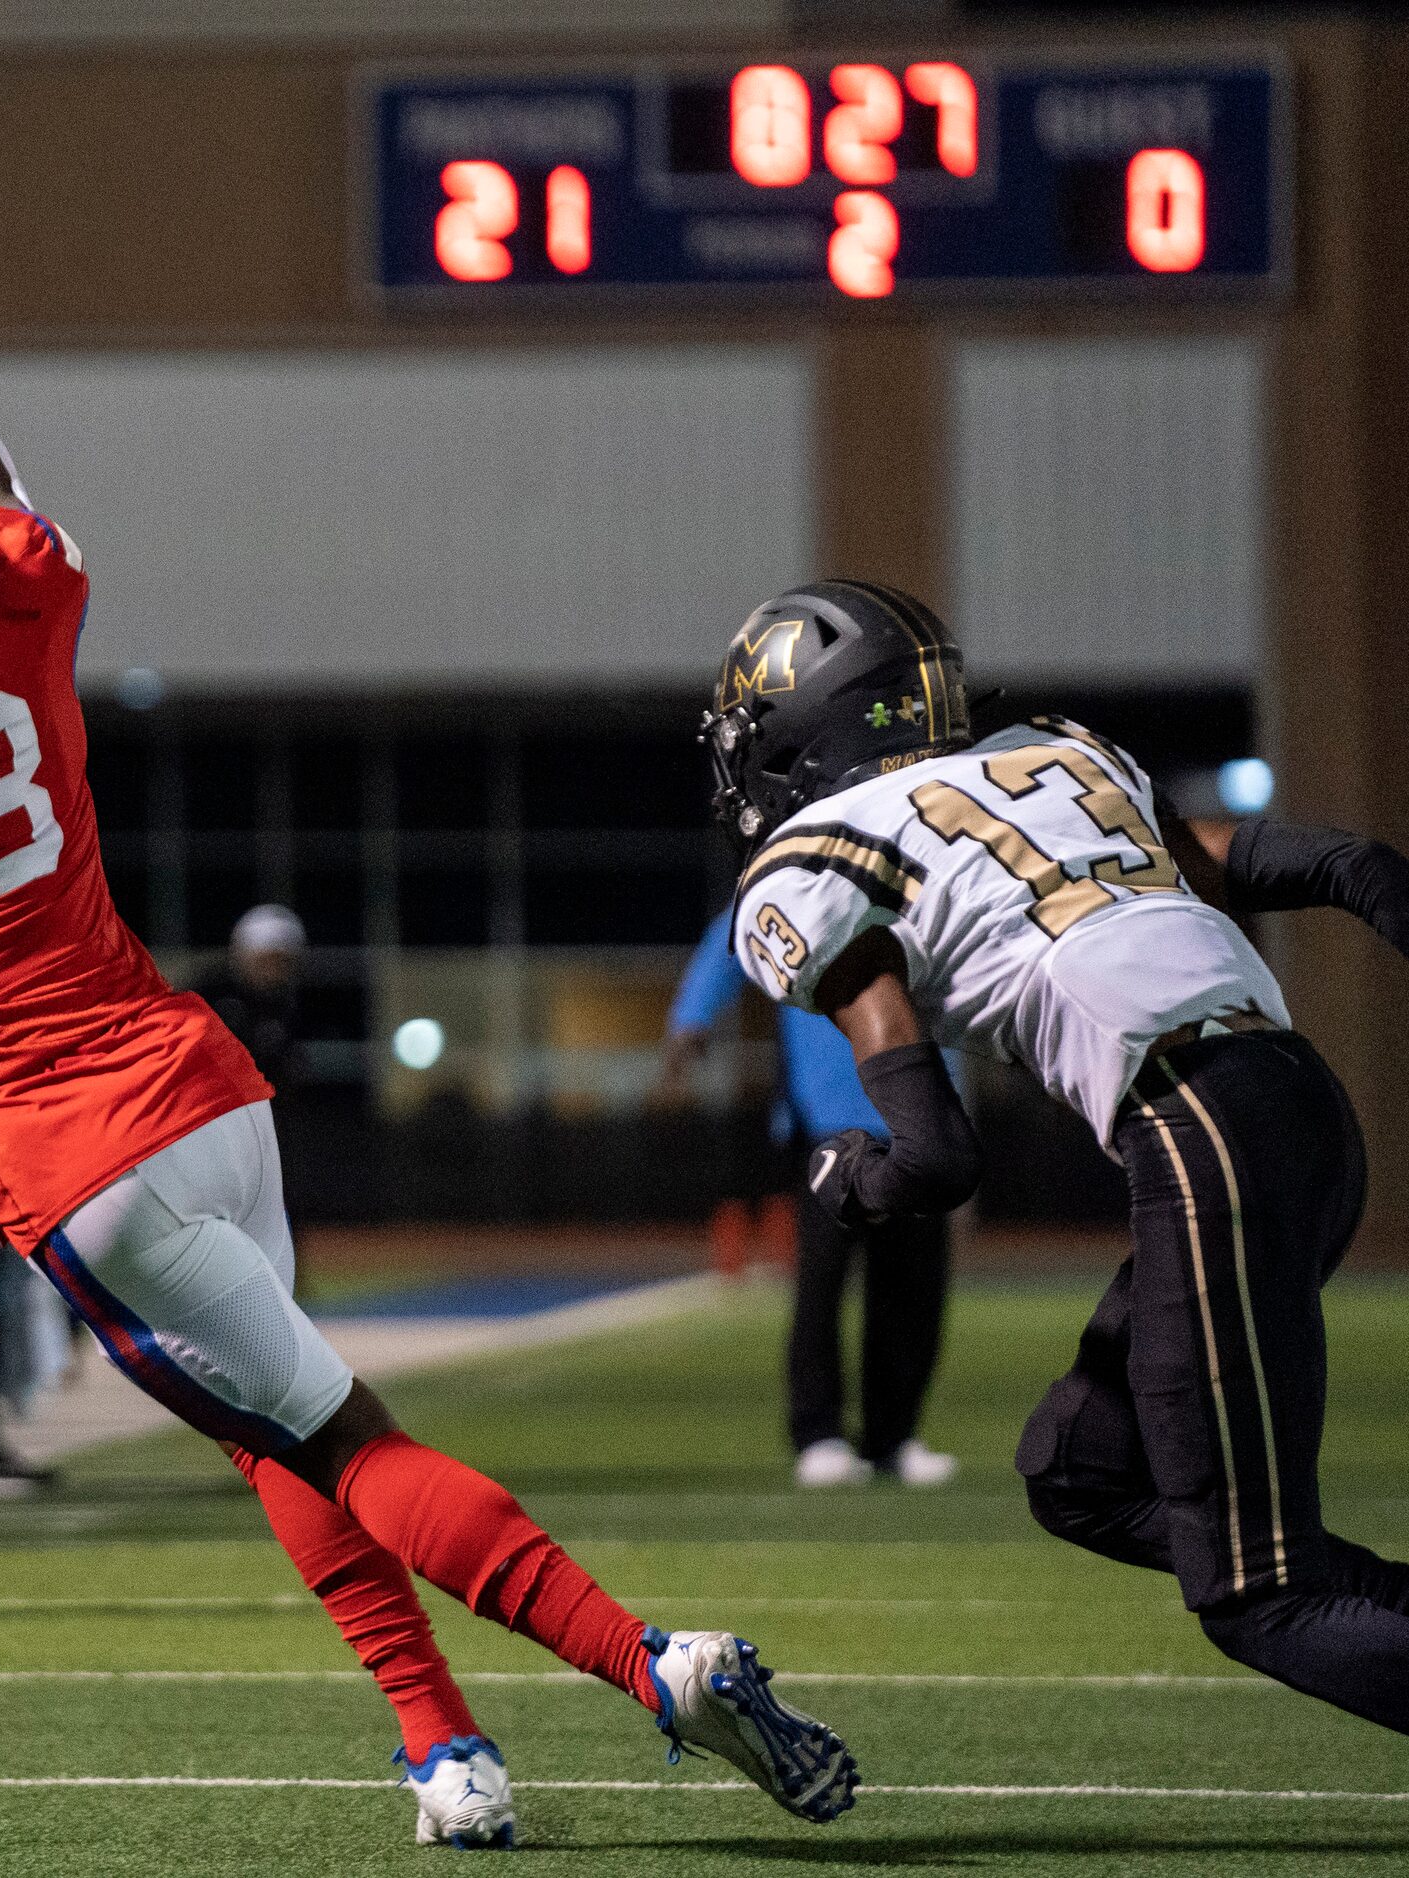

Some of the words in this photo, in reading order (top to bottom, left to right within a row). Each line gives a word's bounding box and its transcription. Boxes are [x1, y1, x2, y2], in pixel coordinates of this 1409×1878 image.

[432, 158, 593, 284] 21
[825, 188, 902, 300] 2
[1124, 147, 1208, 275] 0
[718, 620, 805, 713] M
[907, 744, 1189, 942] 13
[747, 902, 810, 995] 13
